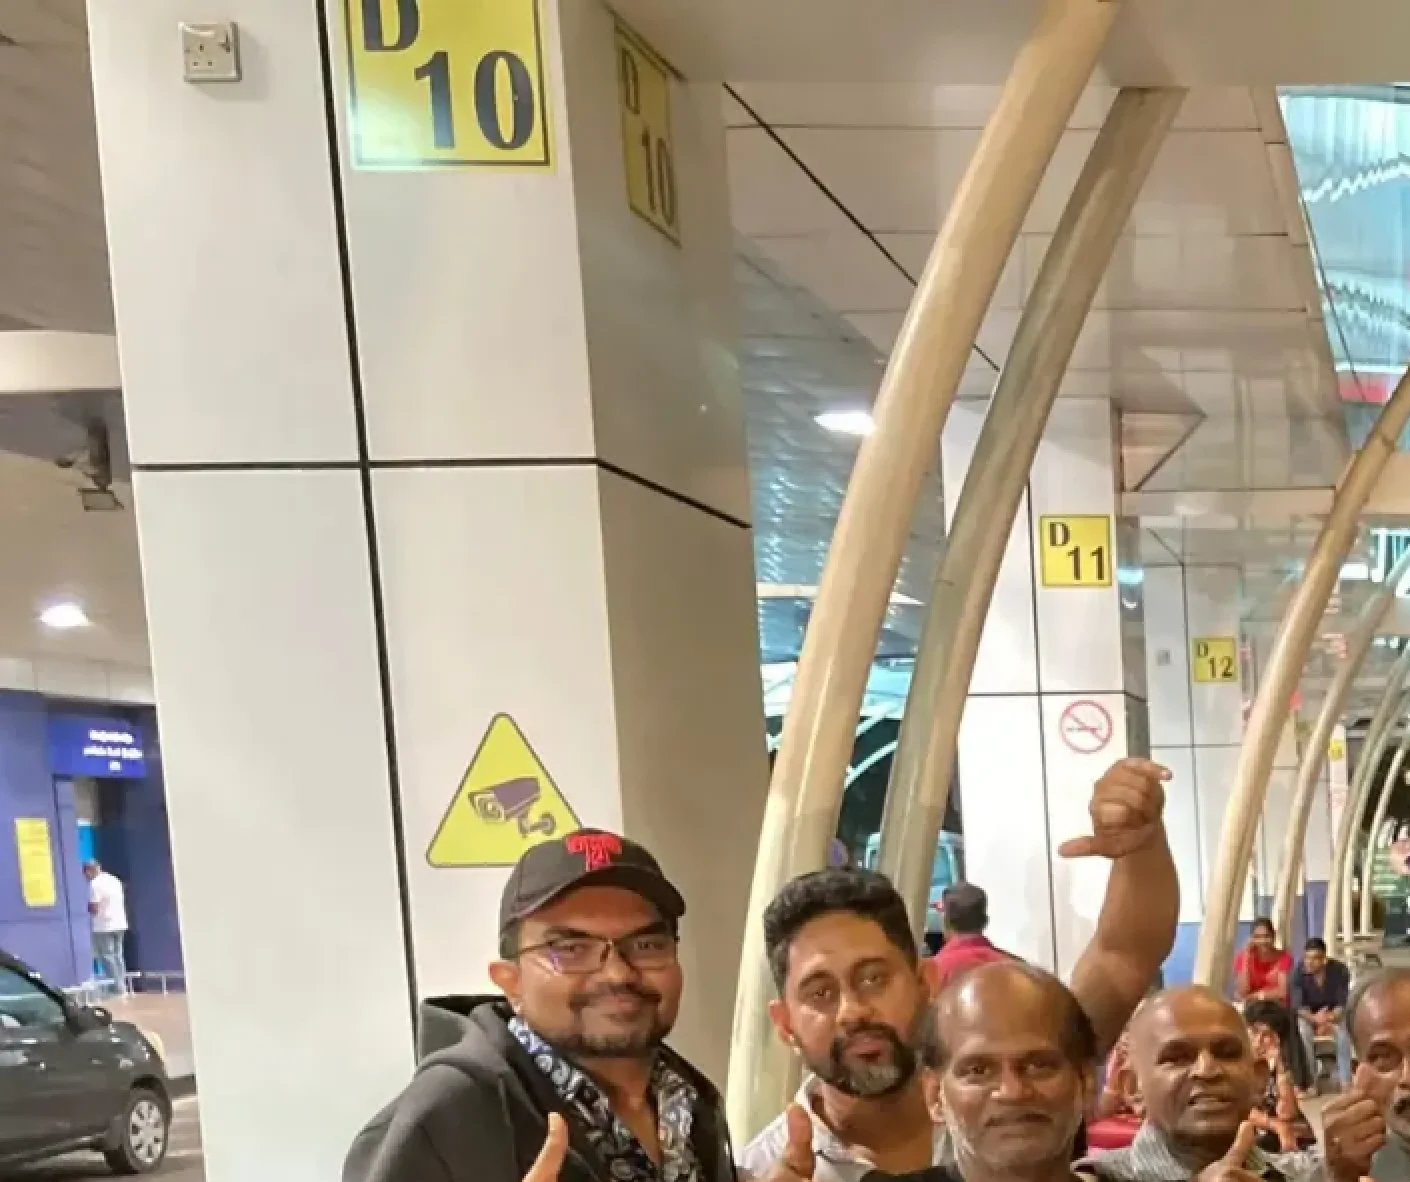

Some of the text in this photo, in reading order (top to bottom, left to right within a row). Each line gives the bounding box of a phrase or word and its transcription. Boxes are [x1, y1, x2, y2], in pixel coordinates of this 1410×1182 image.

[361, 0, 420, 51] D
[414, 50, 535, 150] 10
[621, 48, 640, 115] D
[641, 126, 676, 226] 10
[1050, 522, 1069, 546] D
[1068, 546, 1105, 580] 11
[1197, 642, 1208, 657] D
[1208, 656, 1233, 678] 12
